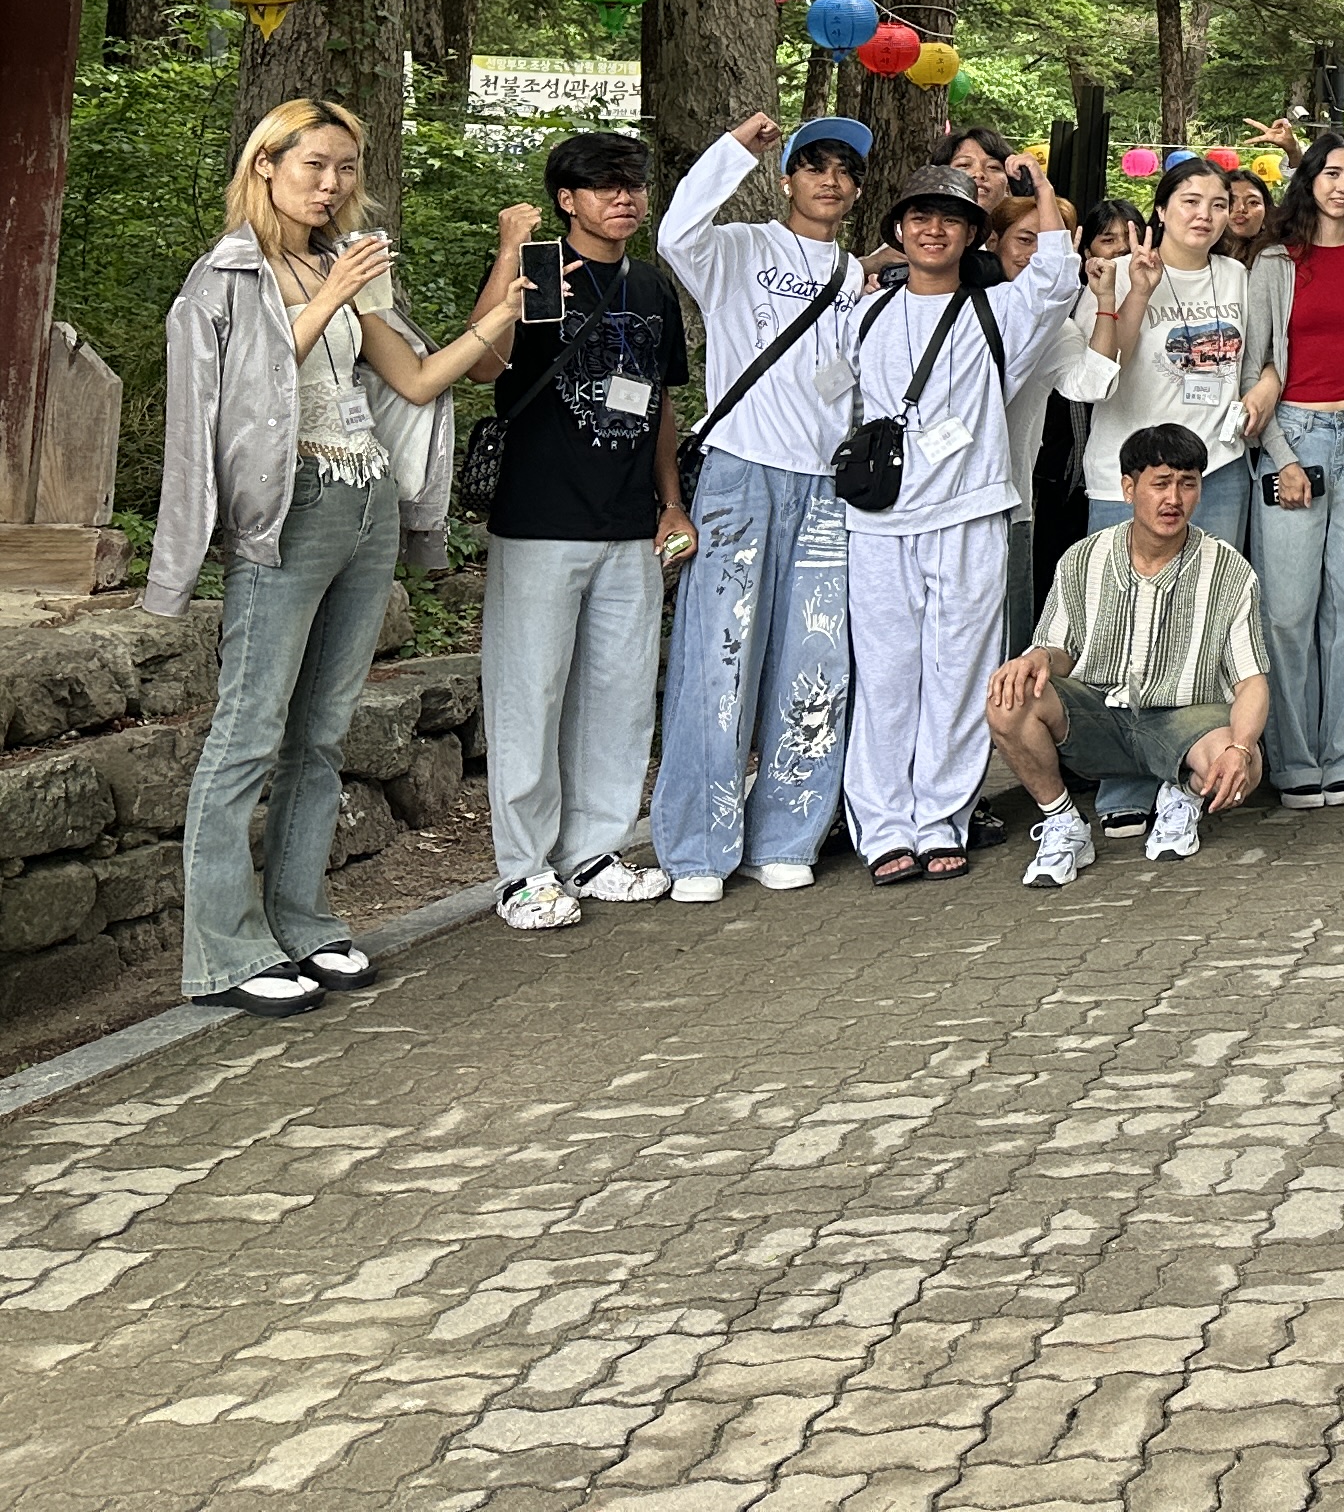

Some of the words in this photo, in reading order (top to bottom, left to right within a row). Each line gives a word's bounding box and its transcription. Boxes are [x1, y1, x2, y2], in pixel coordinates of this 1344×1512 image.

[530, 59, 551, 72] 조상
[1147, 302, 1241, 329] DAMASCUS
[578, 419, 651, 450] PARIS
